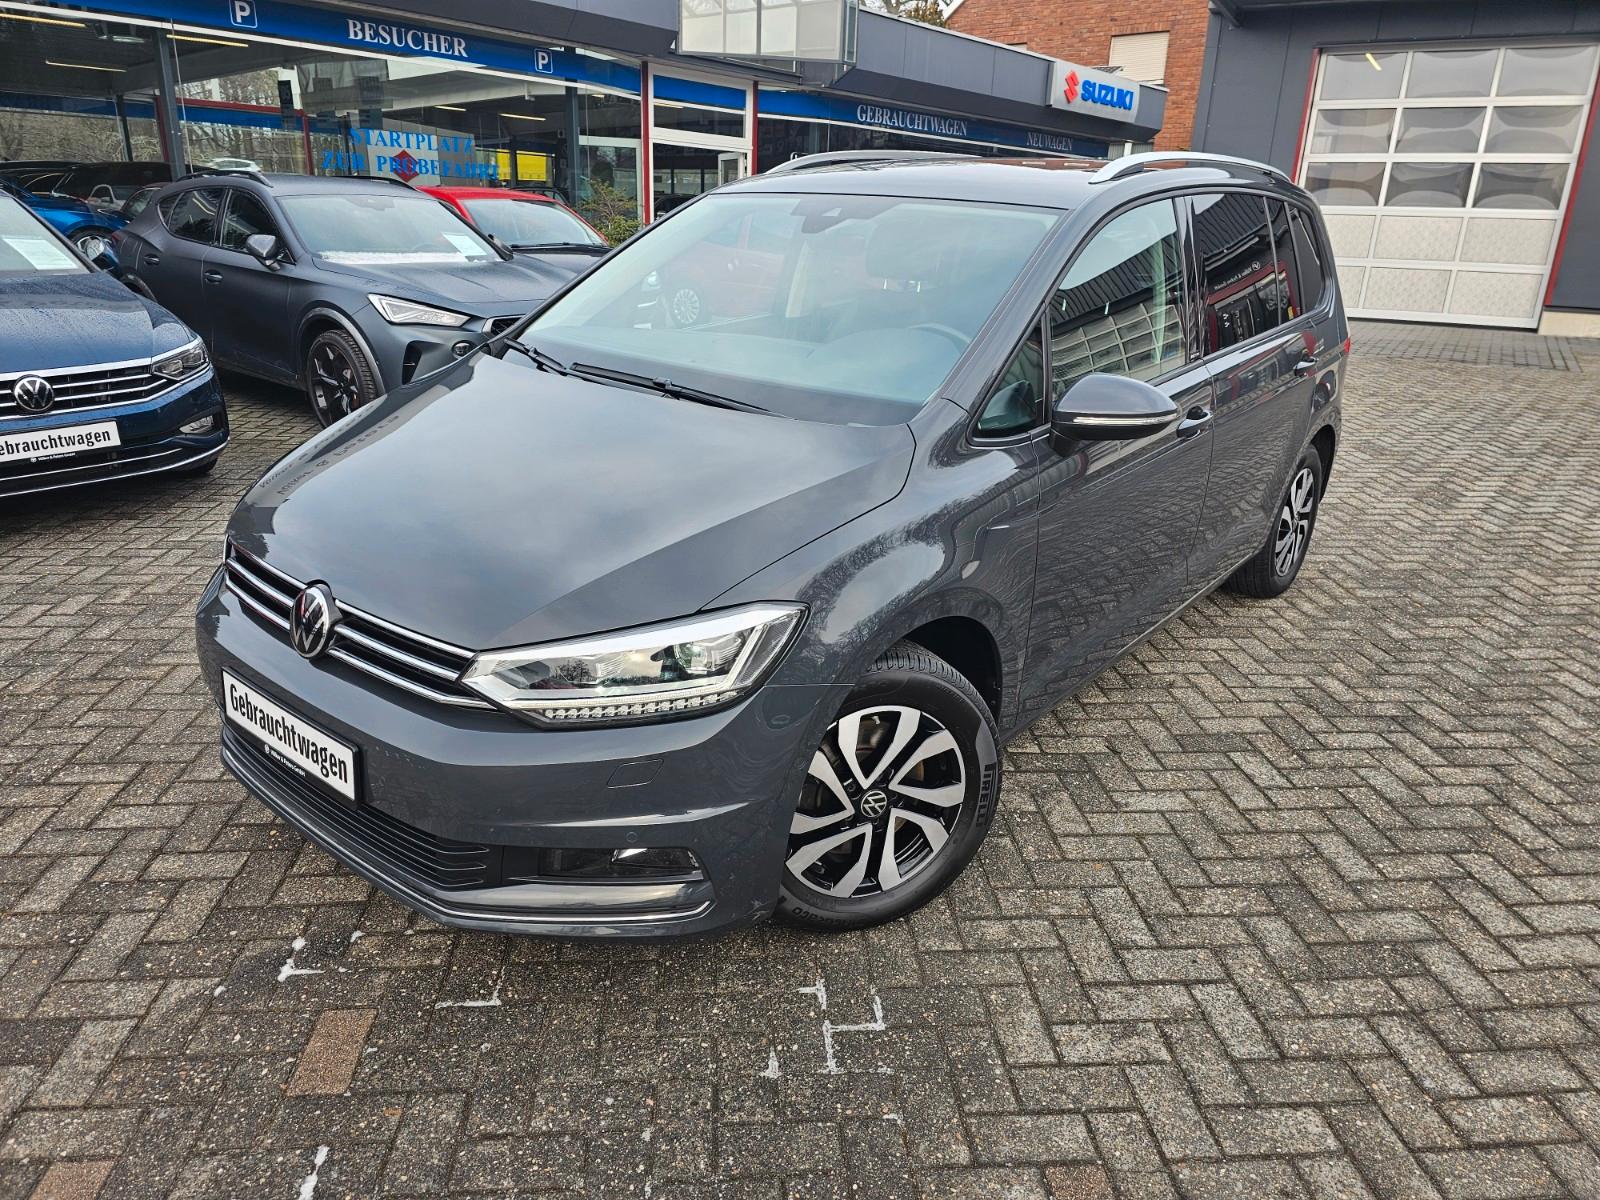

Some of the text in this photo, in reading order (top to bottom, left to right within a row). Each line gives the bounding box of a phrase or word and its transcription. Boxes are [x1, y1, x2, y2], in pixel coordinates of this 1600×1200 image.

[347, 19, 468, 57] BESUCHER
[1081, 78, 1134, 111] SUZUKI
[856, 103, 968, 137] GEBRAUCHTWAGEN
[349, 127, 474, 157] STARTPLATZ
[1026, 131, 1074, 152] NEUWAGEN
[321, 148, 502, 181] ZUR PROBEFAHRT
[230, 683, 349, 783] Gebrauchtwagen
